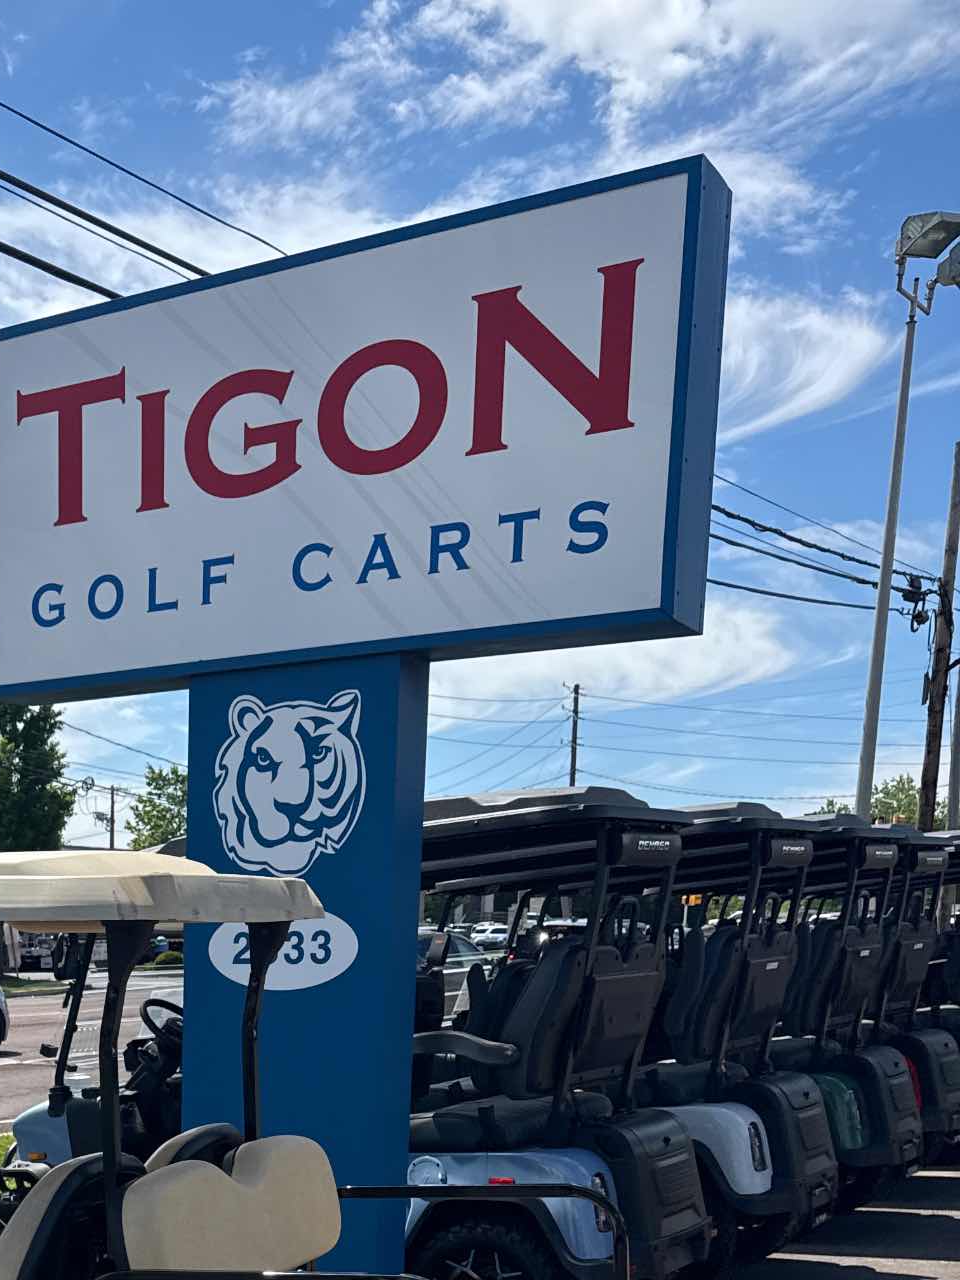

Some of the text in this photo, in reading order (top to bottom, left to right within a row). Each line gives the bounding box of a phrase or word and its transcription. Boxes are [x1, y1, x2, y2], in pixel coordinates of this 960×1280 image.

[16, 258, 645, 527] TIGON
[31, 500, 611, 629] GOLF CARTS
[232, 929, 332, 965] 233
